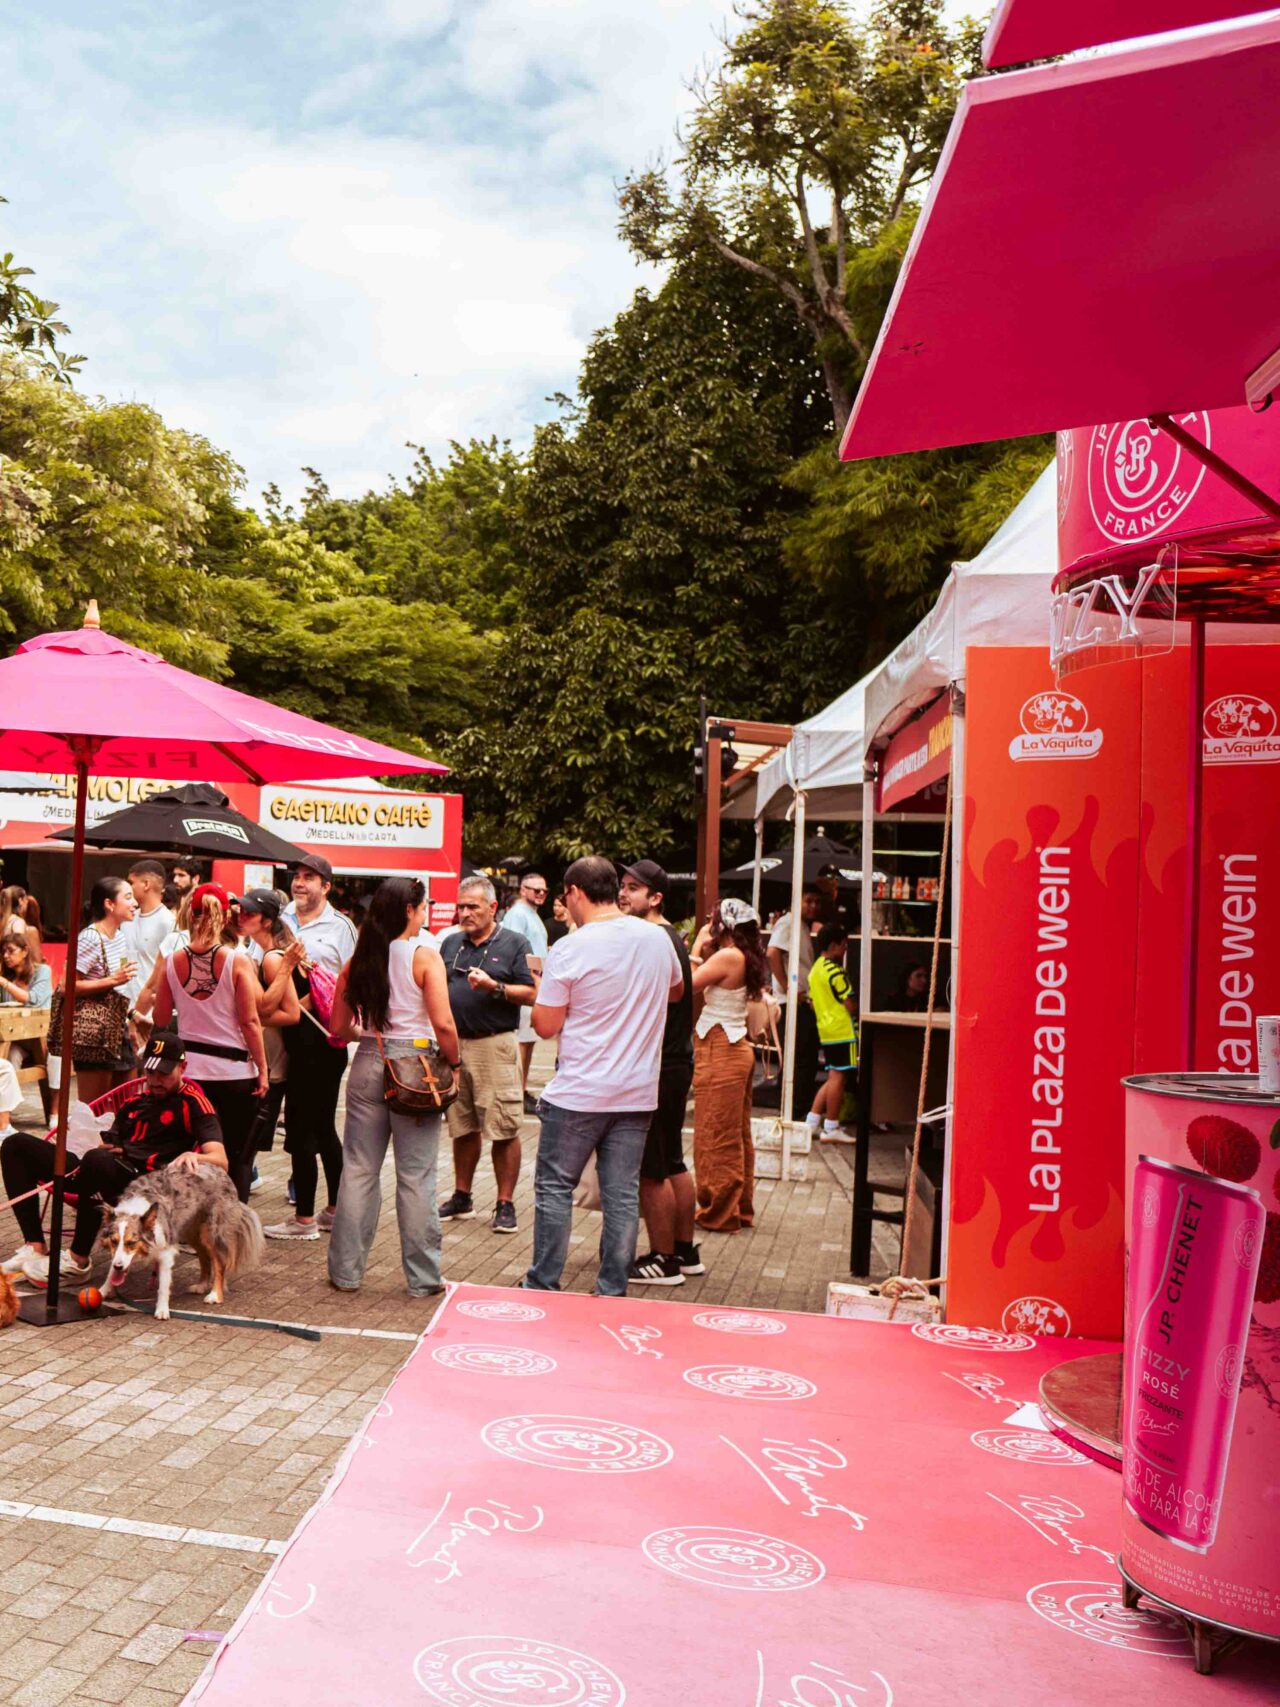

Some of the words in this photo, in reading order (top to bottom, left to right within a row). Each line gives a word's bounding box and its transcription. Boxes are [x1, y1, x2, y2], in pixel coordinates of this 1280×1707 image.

[1104, 485, 1187, 536] FRANCE
[1022, 739, 1039, 750] La
[1041, 735, 1093, 753] Vaquita
[1204, 743, 1222, 755] La
[1224, 739, 1280, 758] Vaquita
[42, 804, 106, 820] MEDELÍN
[305, 825, 356, 842] MEDELLÍN
[368, 831, 398, 843] CARTA
[1166, 1194, 1204, 1304] CHENET
[1158, 1310, 1176, 1345] JP.
[1139, 1344, 1191, 1381] FIZZY
[1142, 1370, 1181, 1400] ROSÉ
[1138, 1388, 1184, 1419] FRIZZANTE
[489, 1416, 536, 1456] FRANCE
[587, 1439, 663, 1471] CHENET
[1144, 1467, 1162, 1492] DE
[1149, 1492, 1181, 1524] PARA
[1184, 1511, 1199, 1530] LA
[649, 1531, 690, 1573] FRANCE
[748, 1538, 788, 1554] JP.
[751, 1553, 814, 1588] CHENET
[1213, 1579, 1253, 1596] EXCESO
[1256, 1591, 1270, 1600] DE
[1218, 1589, 1271, 1608] EXPENDIO
[1037, 1593, 1131, 1647] FRANCE
[1262, 1608, 1277, 1618] DE
[513, 1643, 560, 1660] JP.
[568, 1659, 613, 1707] CHEN
